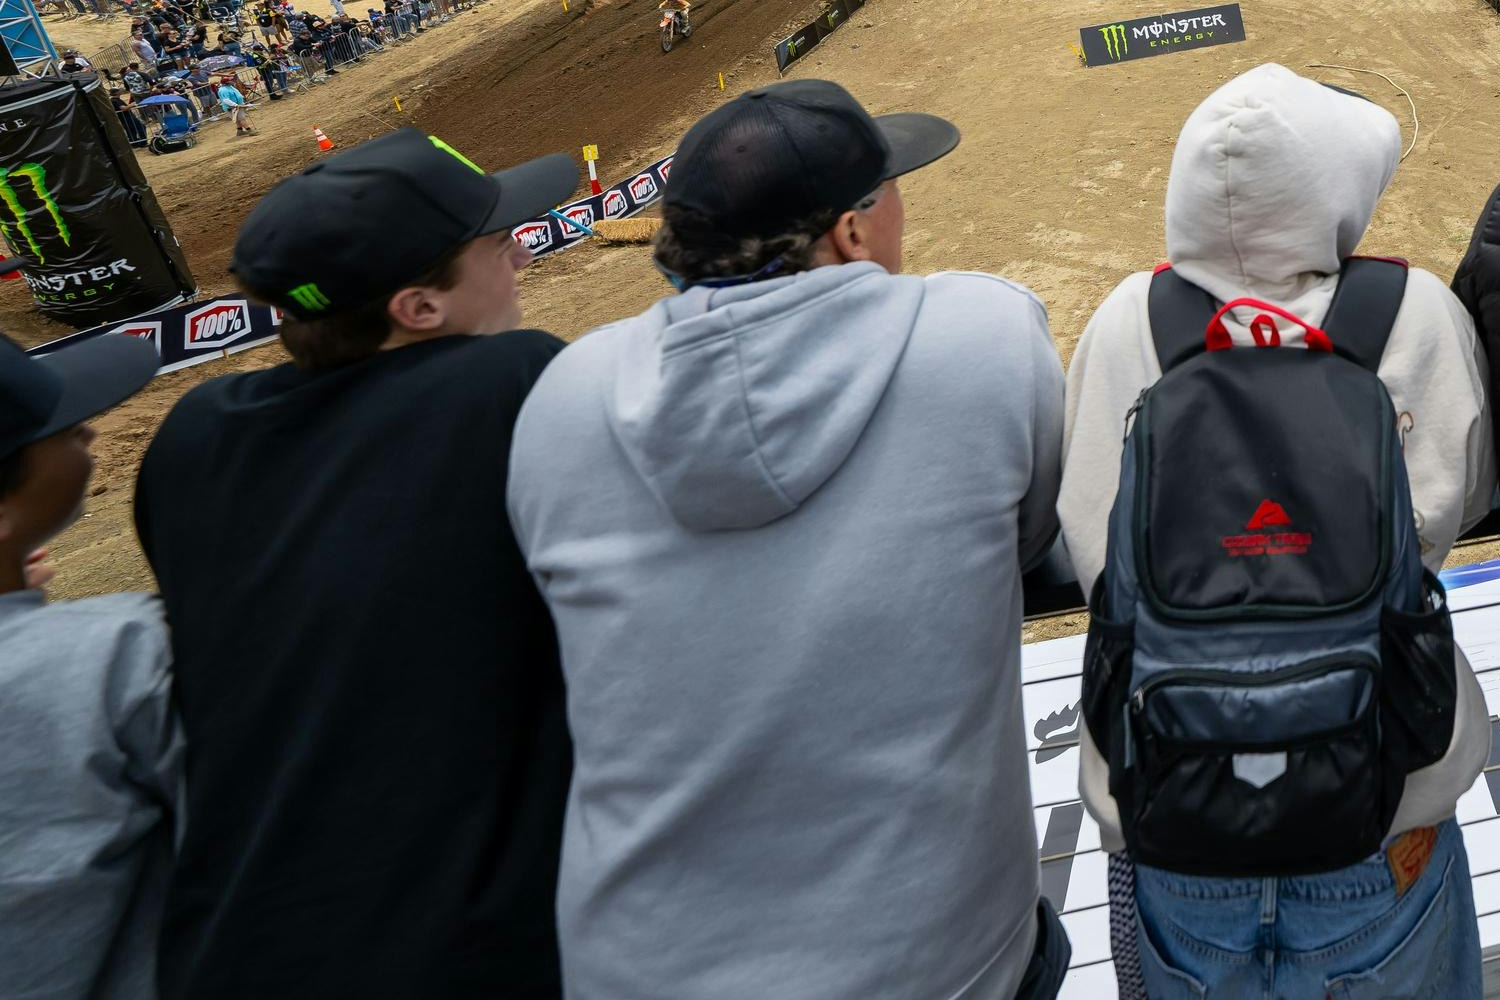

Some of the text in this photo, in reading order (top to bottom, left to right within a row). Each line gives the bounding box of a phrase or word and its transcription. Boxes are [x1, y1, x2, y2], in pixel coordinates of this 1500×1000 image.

[1132, 13, 1227, 40] MONSTER
[1150, 31, 1215, 47] ENERGY
[634, 180, 653, 201] 100%
[607, 194, 624, 216] 100%
[518, 226, 548, 249] 100%
[23, 258, 136, 292] ONSTER
[194, 307, 242, 341] 100%
